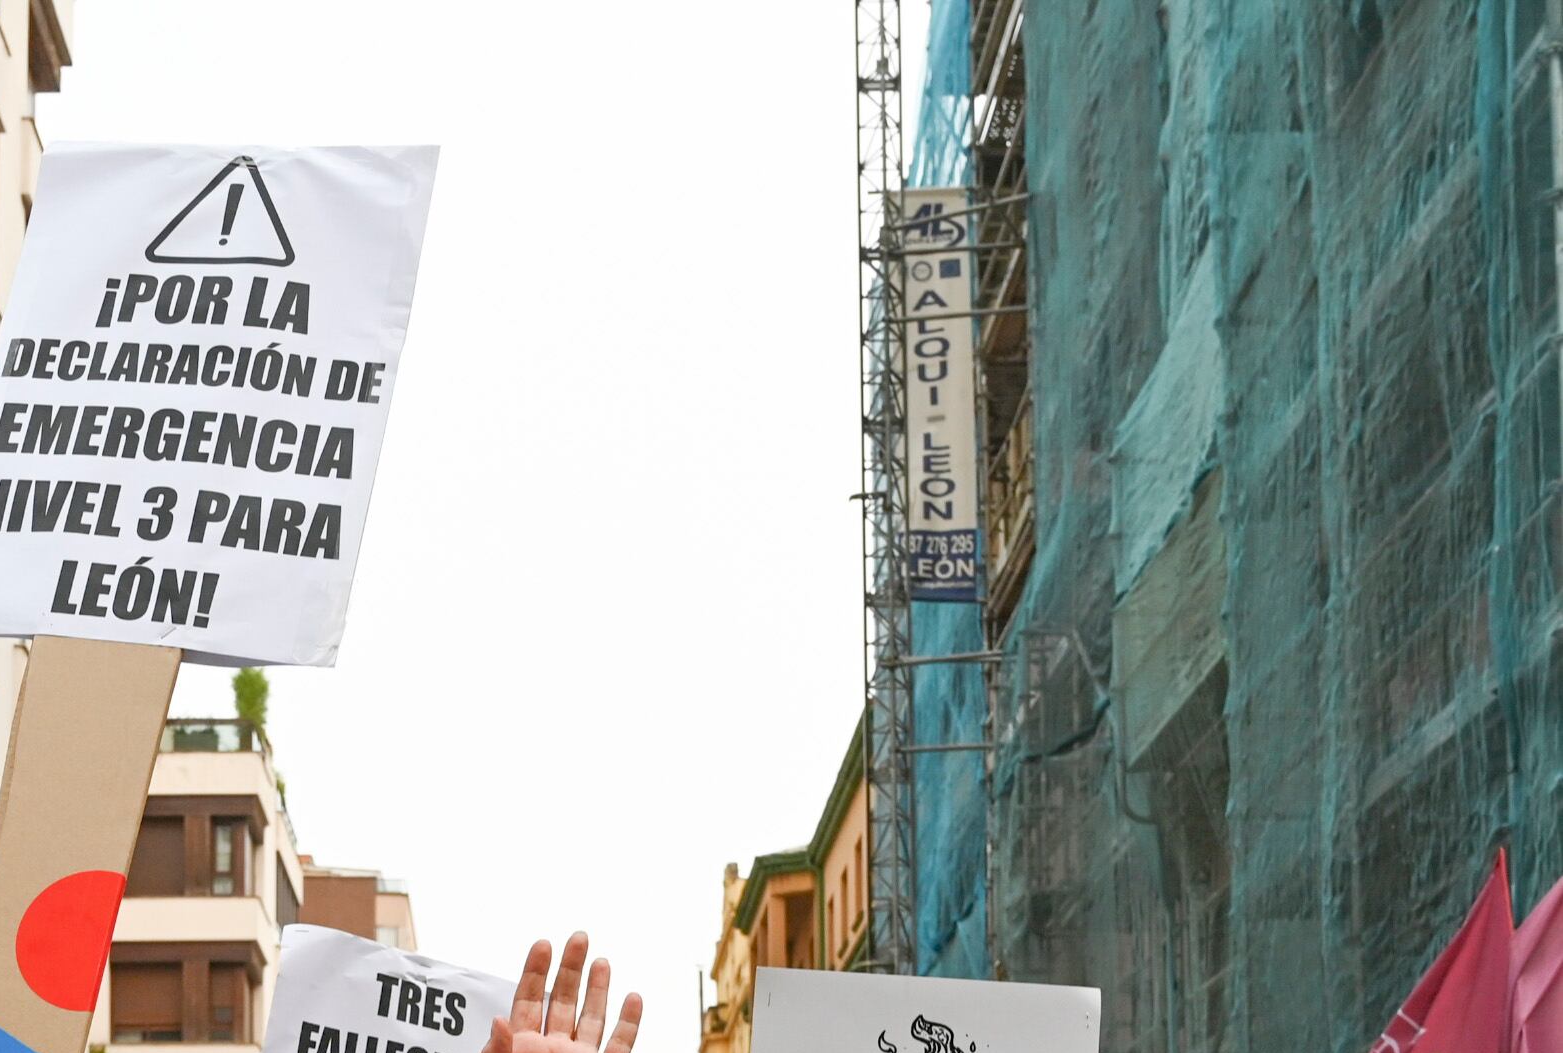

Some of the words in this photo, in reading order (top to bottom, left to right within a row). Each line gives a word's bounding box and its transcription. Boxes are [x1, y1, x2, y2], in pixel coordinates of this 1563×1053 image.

[95, 273, 233, 328] ¡POR
[242, 275, 311, 335] LA
[1, 337, 318, 398] DECLARACIÓN
[324, 360, 386, 404] DE
[135, 486, 178, 542] 3
[188, 489, 342, 560] PARA
[50, 556, 220, 629] LEÓN!
[376, 973, 467, 1037] TRES
